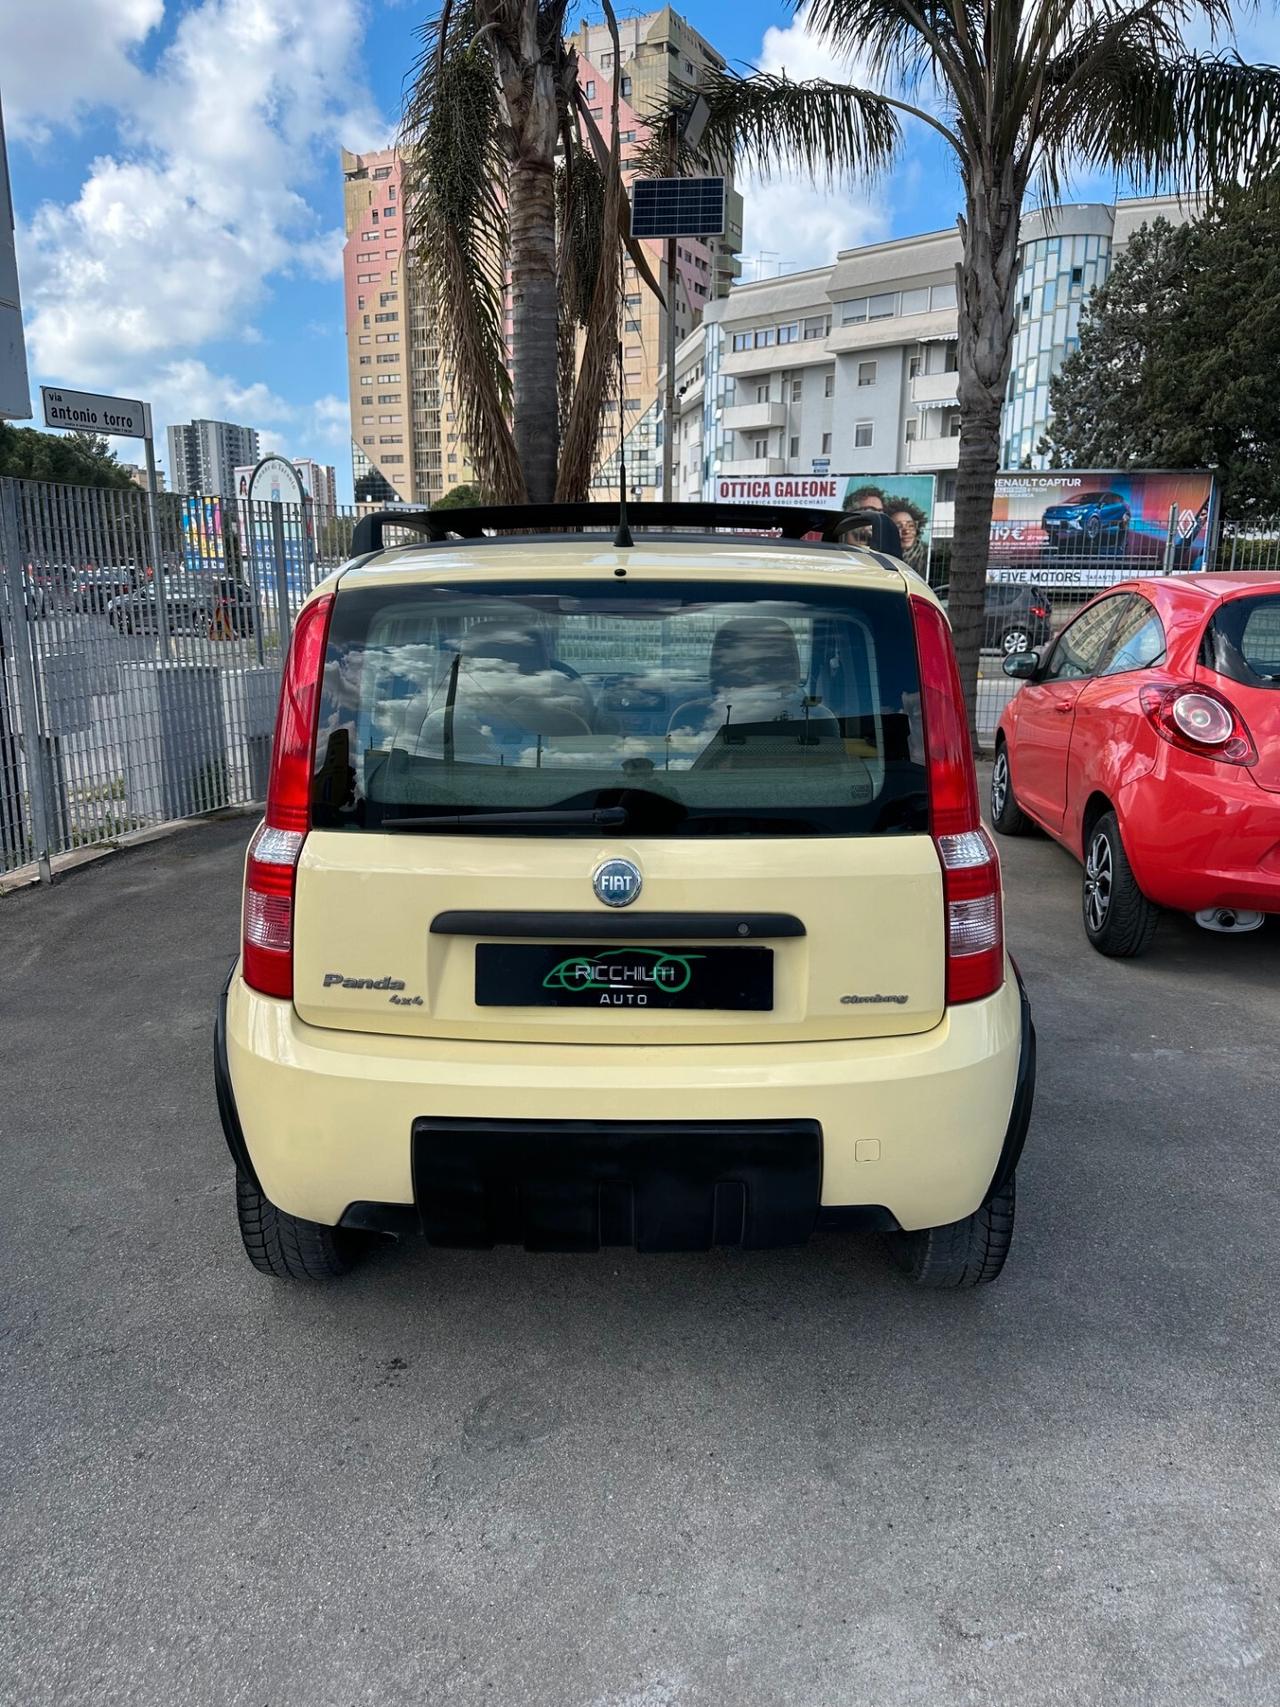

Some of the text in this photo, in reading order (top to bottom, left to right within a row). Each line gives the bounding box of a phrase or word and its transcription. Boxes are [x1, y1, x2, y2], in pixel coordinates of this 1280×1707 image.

[49, 392, 62, 402] via
[51, 406, 97, 424] antonio
[104, 411, 133, 428] torro
[1039, 478, 1082, 487] CAPTUR
[720, 480, 837, 498] OTTICA GALEONE
[1000, 572, 1028, 582] FIVE
[1030, 571, 1081, 582] MOTORS
[601, 875, 633, 891] FIAT
[323, 974, 405, 990] Panda
[389, 994, 424, 1006] 4x4
[600, 993, 647, 1005] AUTO
